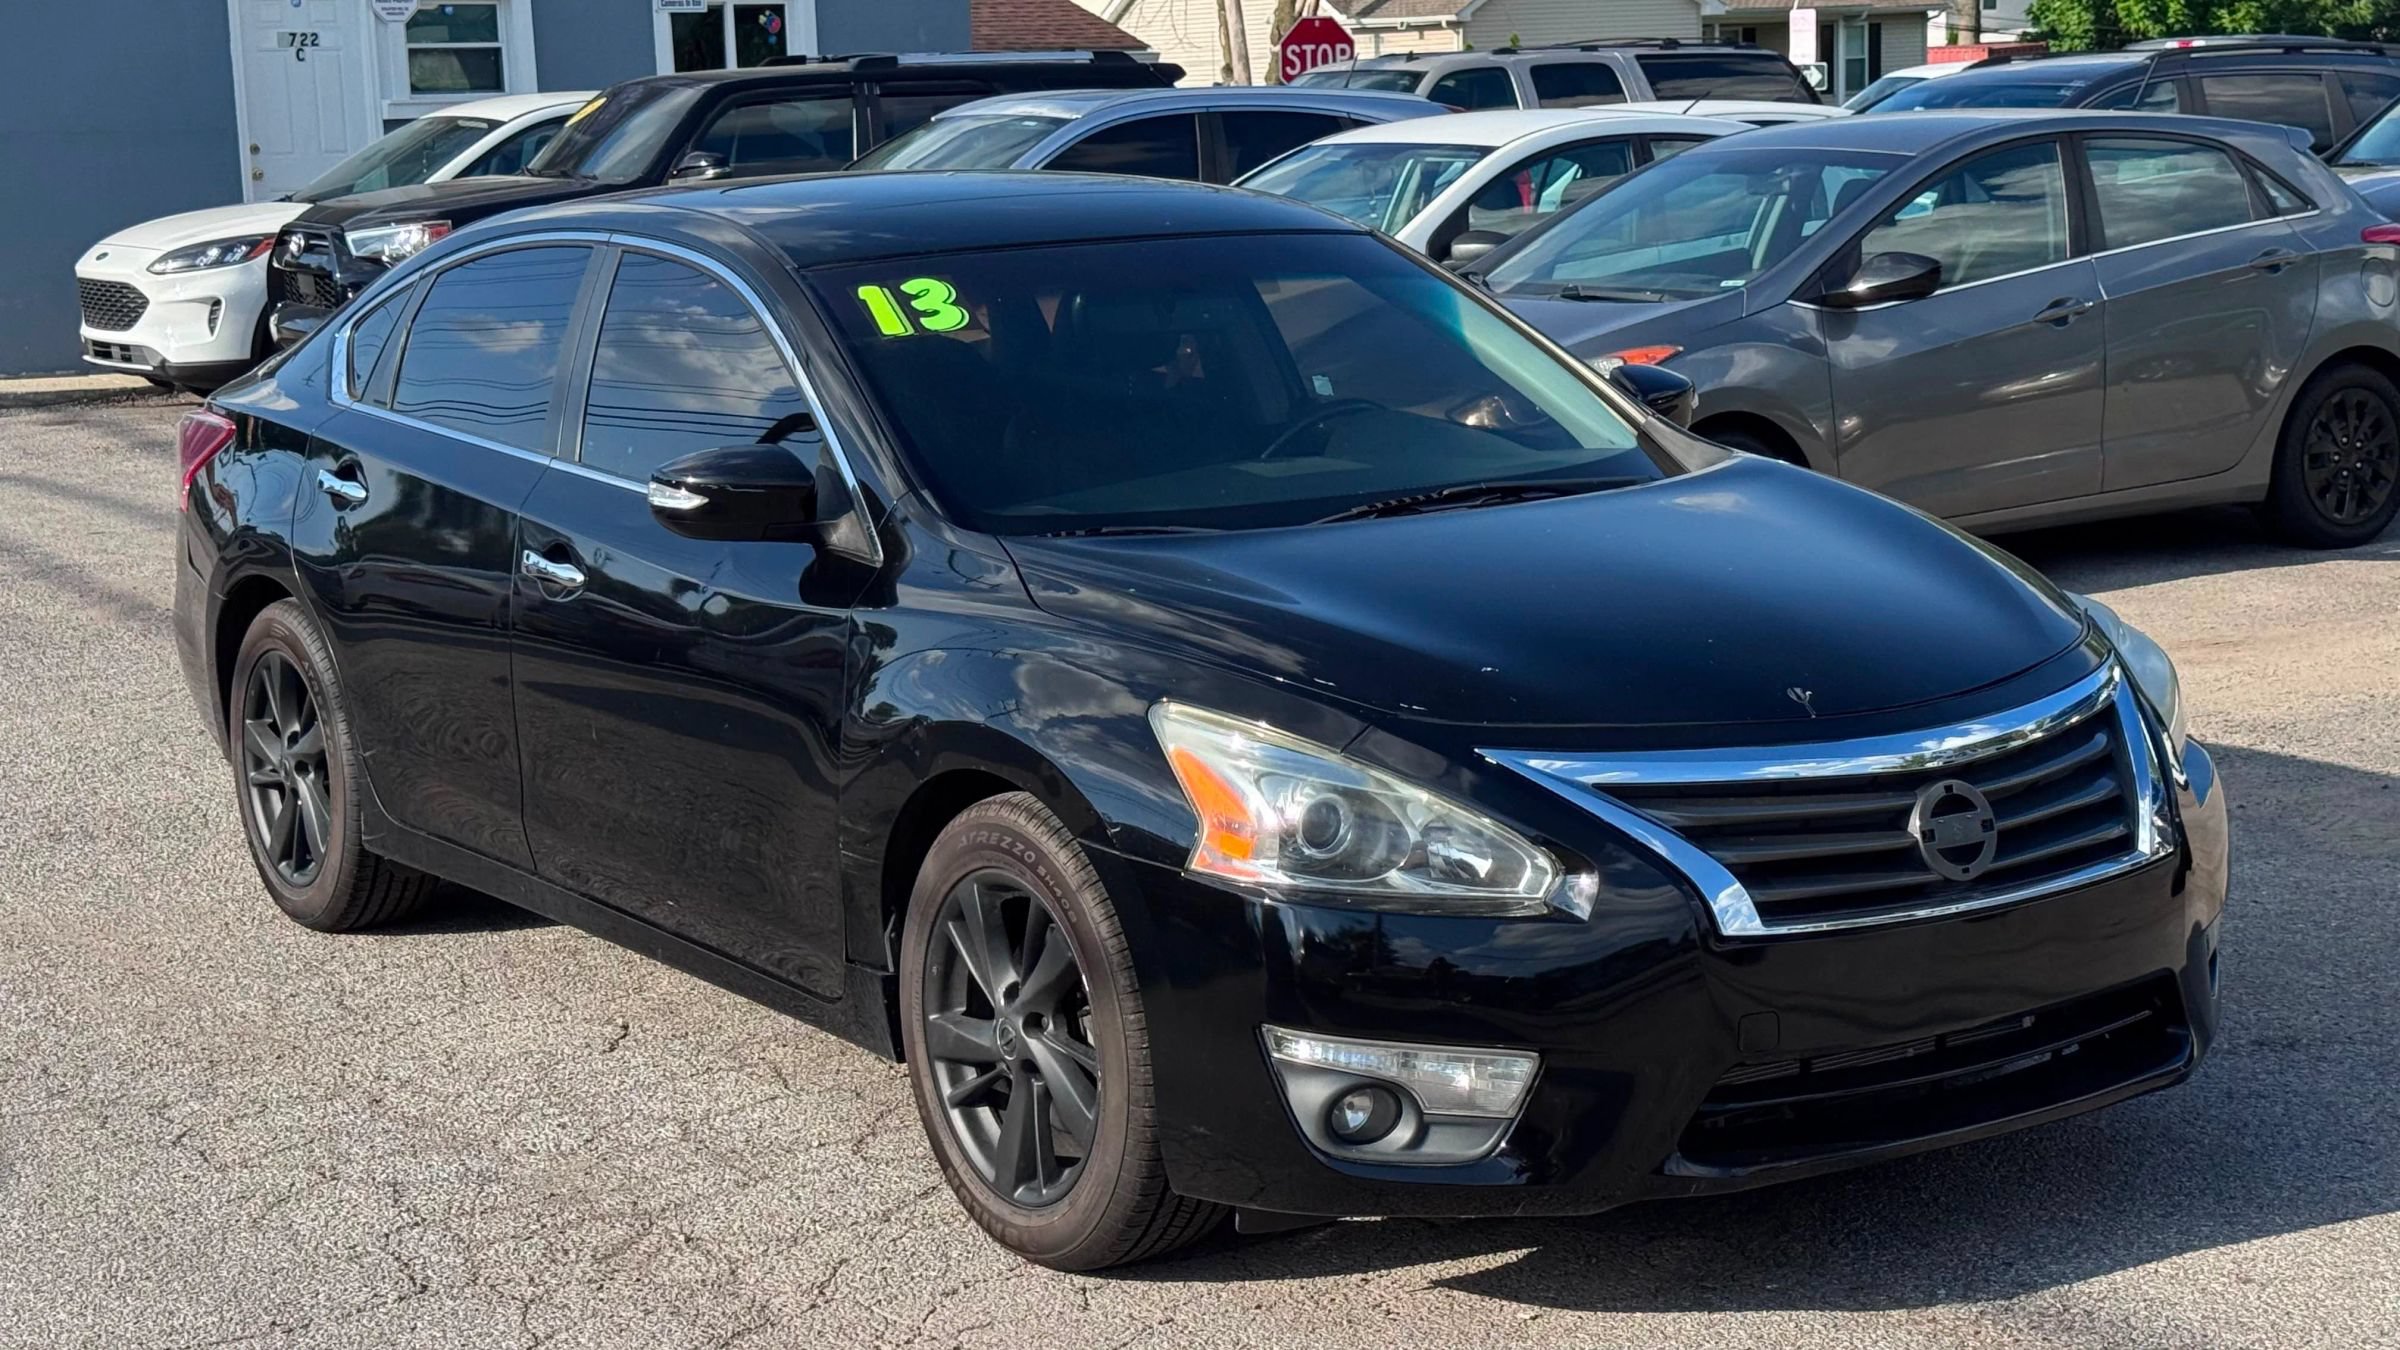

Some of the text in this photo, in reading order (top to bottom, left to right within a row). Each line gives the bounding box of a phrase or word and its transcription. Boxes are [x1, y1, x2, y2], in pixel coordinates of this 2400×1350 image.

[288, 32, 319, 47] 722
[296, 48, 305, 62] C
[1285, 43, 1351, 76] STOP
[857, 277, 970, 337] 13
[959, 830, 1036, 864] ATREZZO
